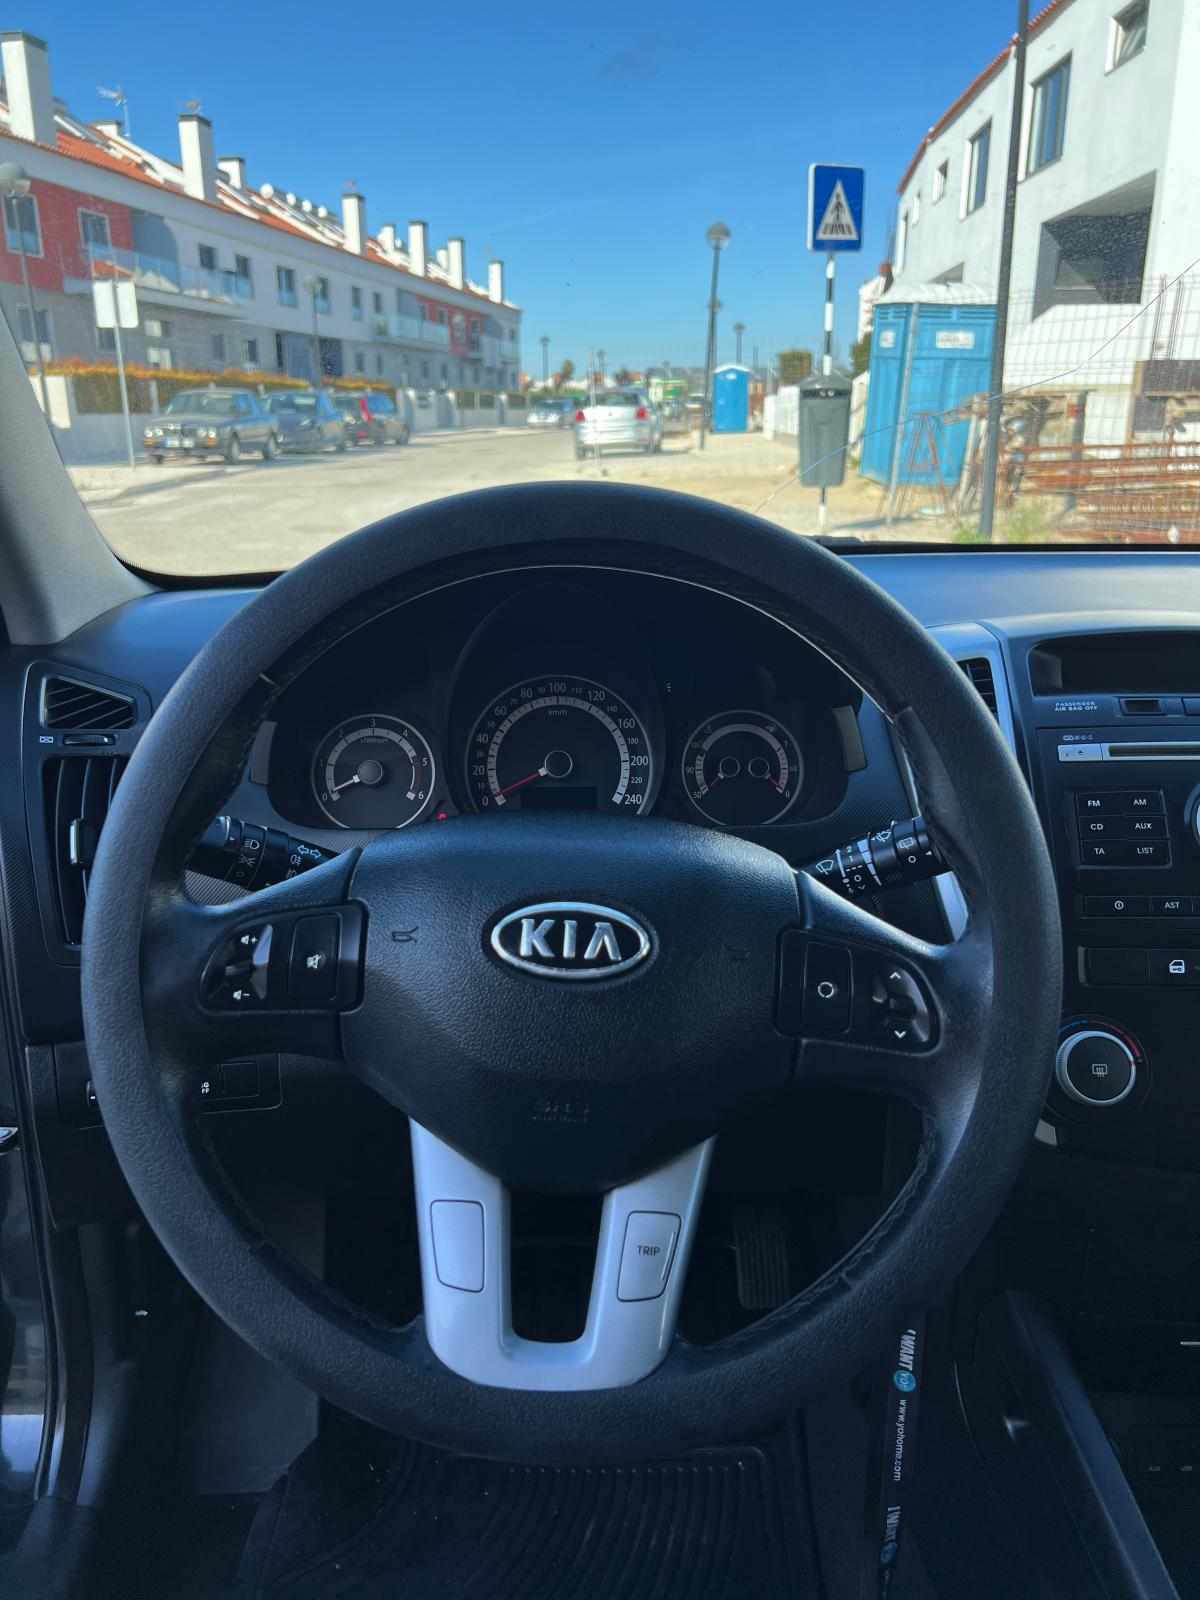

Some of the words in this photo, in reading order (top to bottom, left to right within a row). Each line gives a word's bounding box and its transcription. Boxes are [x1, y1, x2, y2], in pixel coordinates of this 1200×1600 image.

[520, 687, 533, 698] 80
[587, 690, 606, 701] 120
[494, 706, 507, 716] 60
[370, 718, 377, 727] 3
[617, 717, 635, 729] 160
[402, 729, 409, 737] 4
[476, 733, 489, 744] 40
[422, 757, 429, 767] 5
[630, 755, 649, 767] 200
[472, 764, 486, 776] 20
[631, 776, 643, 784] 220
[418, 791, 425, 800] 6
[624, 794, 643, 806] 240
[482, 796, 489, 806] 0
[1087, 799, 1101, 808] FM
[1133, 798, 1147, 807] AM
[1090, 822, 1104, 831] CD
[1135, 822, 1153, 830] AUX
[1094, 847, 1105, 855] TA
[1136, 847, 1154, 855] LIST
[1164, 901, 1180, 909] AST
[519, 918, 622, 961] KIA
[637, 1244, 661, 1256] TRIP
[898, 1334, 916, 1371] WANT
